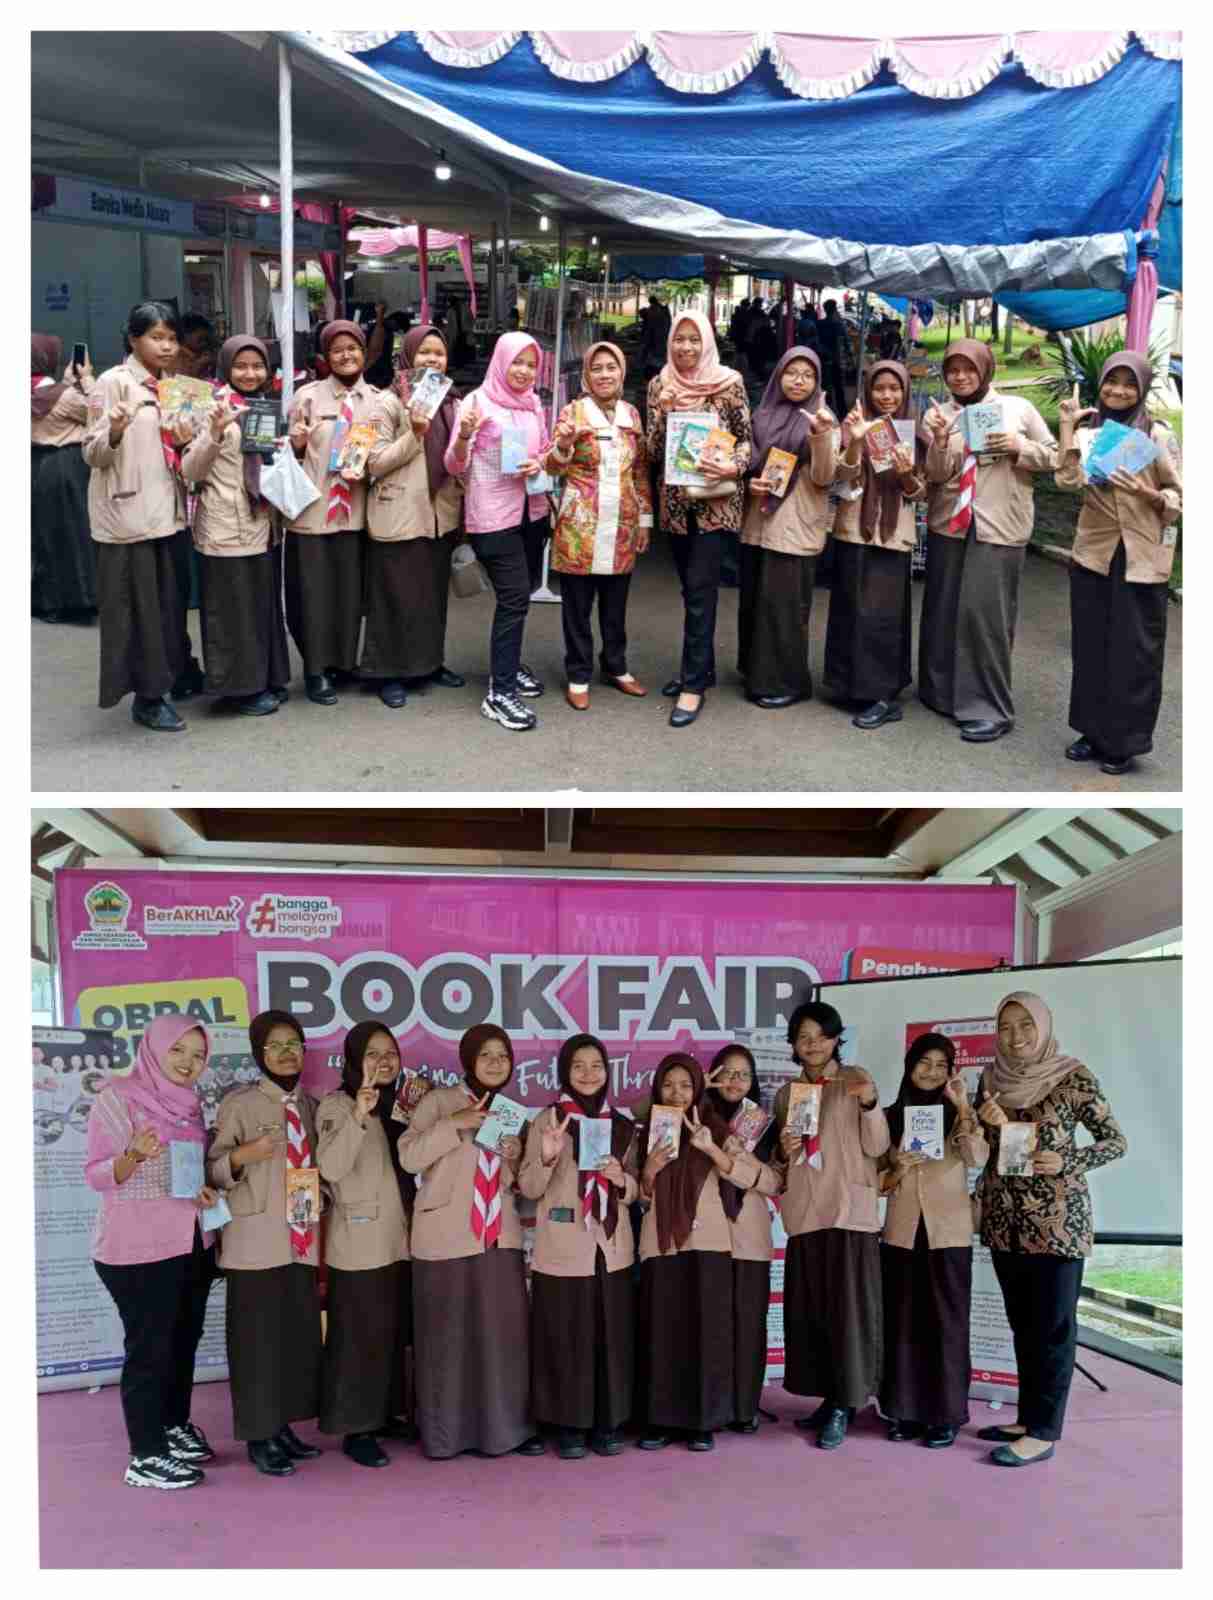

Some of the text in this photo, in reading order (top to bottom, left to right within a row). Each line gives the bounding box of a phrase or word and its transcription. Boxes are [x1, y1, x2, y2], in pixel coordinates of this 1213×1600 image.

[277, 898, 328, 912] bangga
[146, 908, 235, 921] BerAKHLAK
[278, 911, 338, 923] melayani
[278, 924, 328, 936] bangsa
[264, 956, 817, 1035] BOOK FAIR
